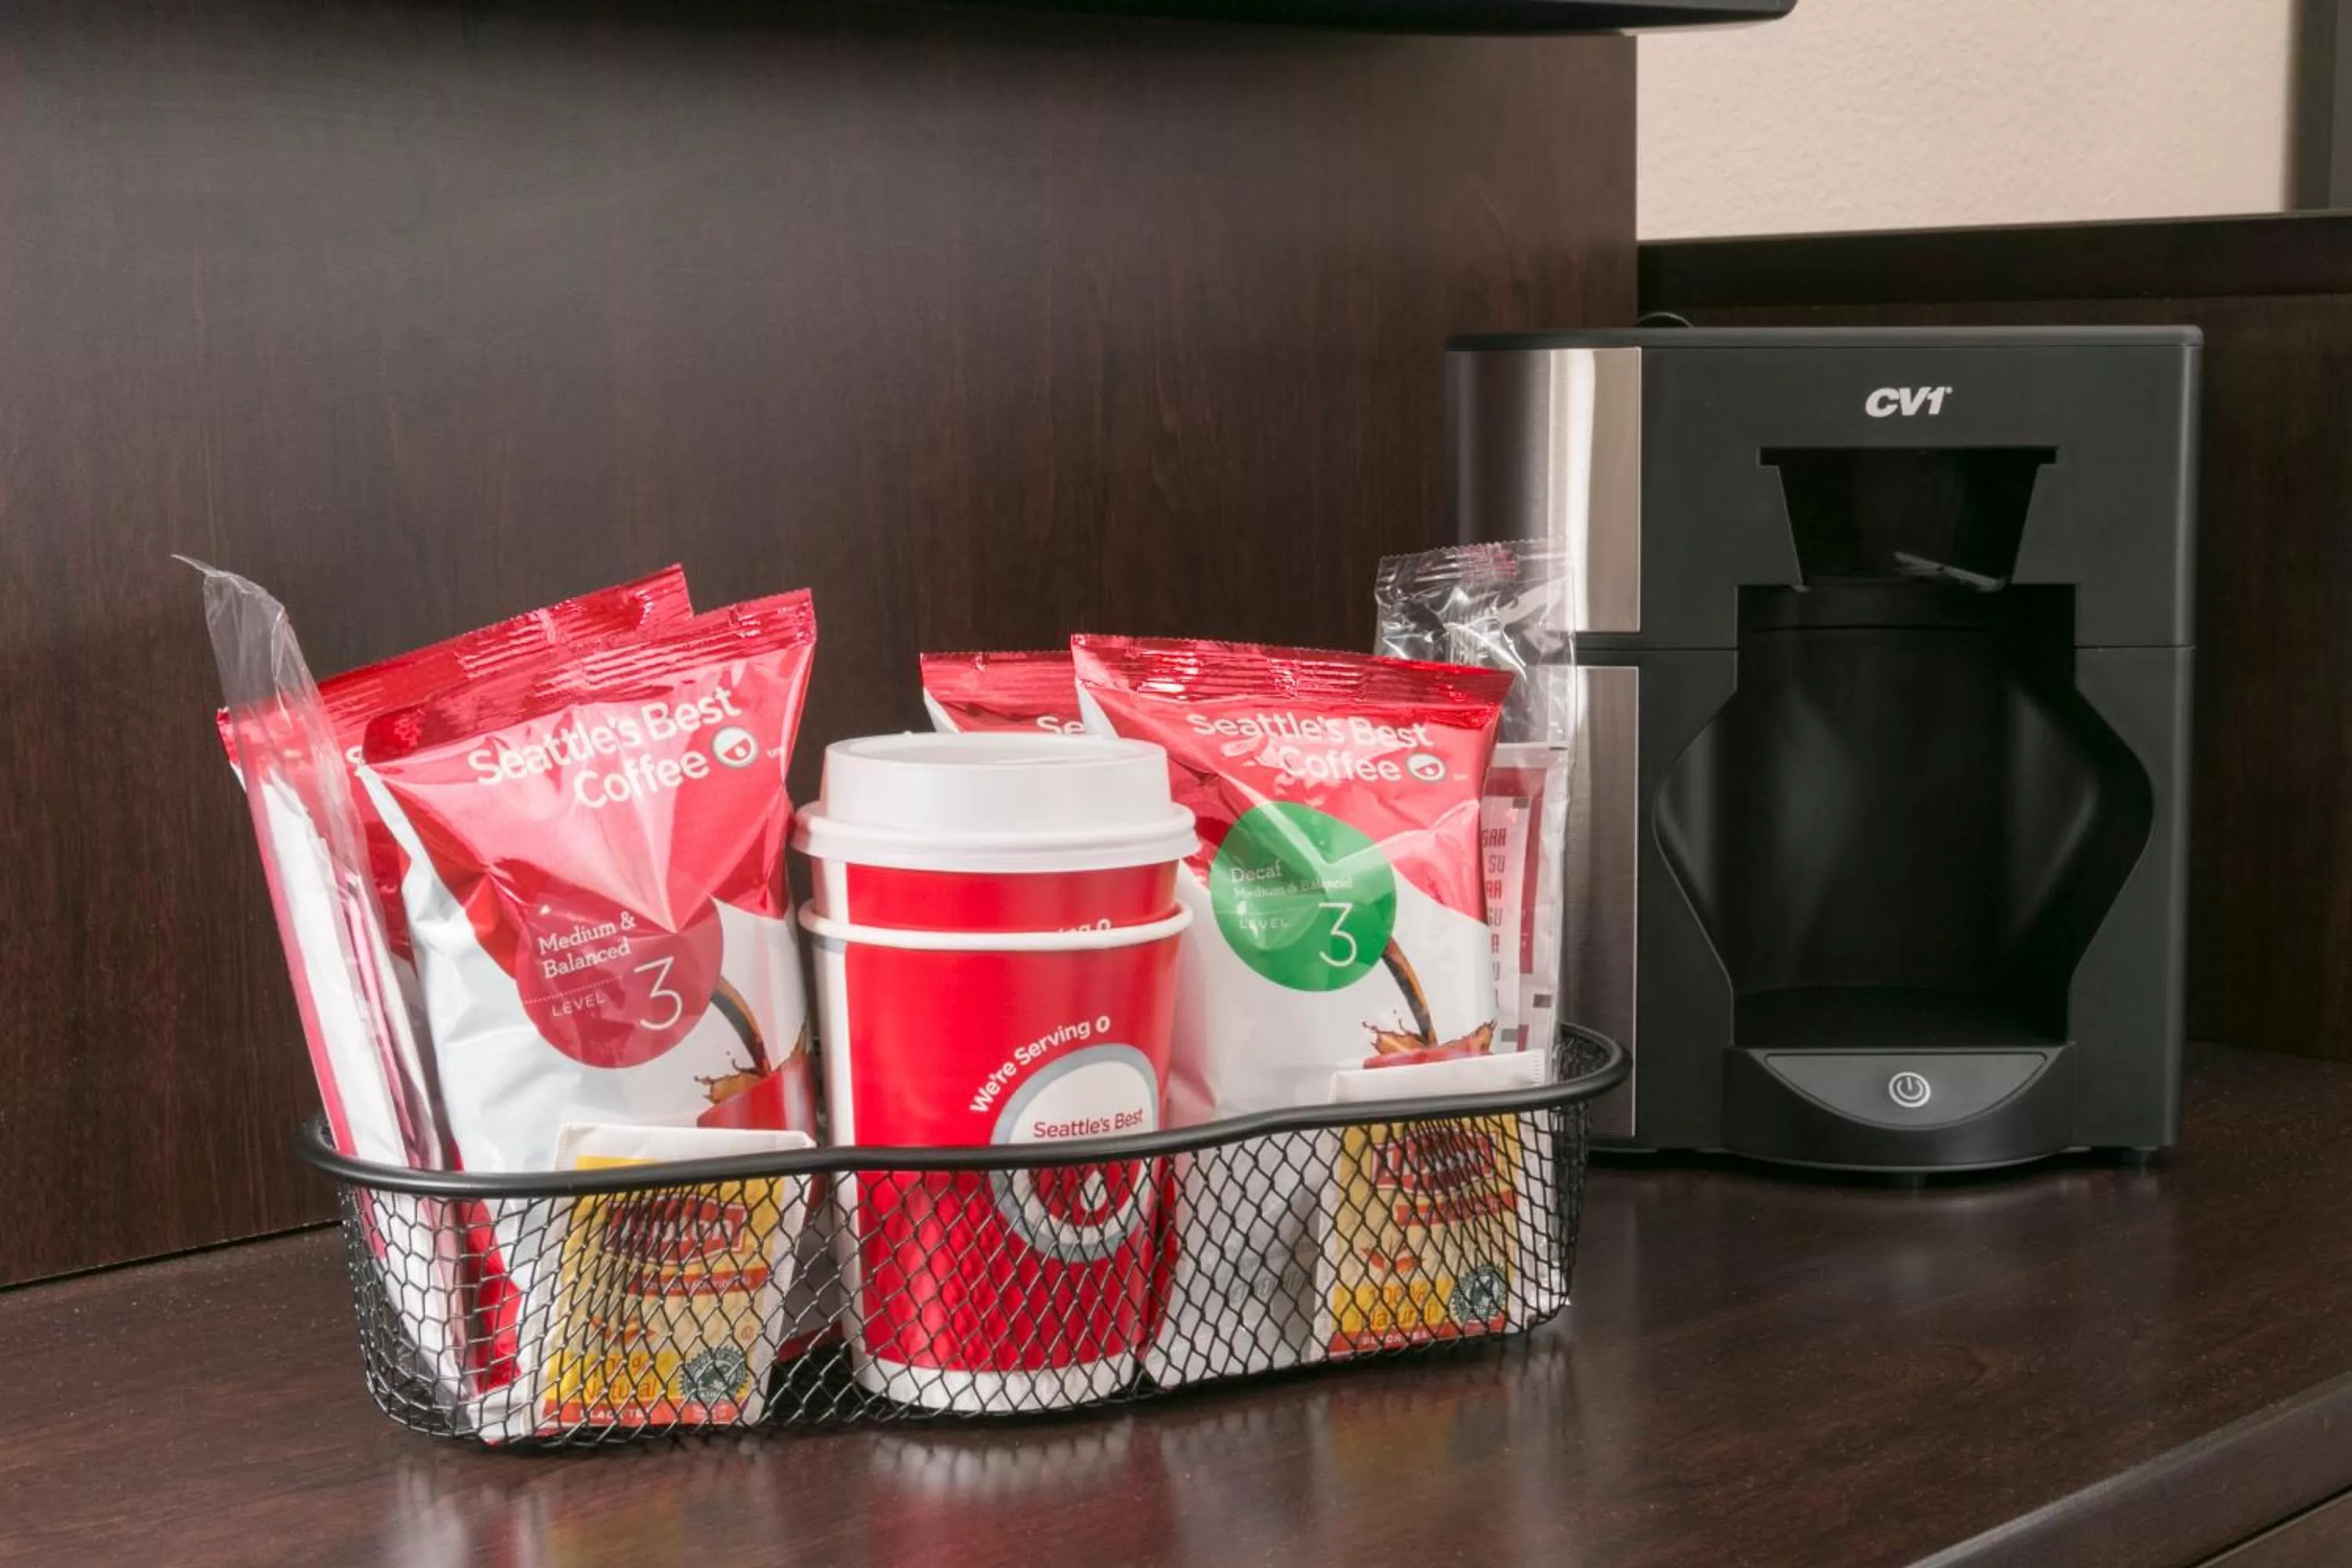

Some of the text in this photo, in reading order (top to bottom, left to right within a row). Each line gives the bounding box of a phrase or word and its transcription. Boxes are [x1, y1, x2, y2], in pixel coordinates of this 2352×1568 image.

[468, 686, 742, 785] Seattle's Best
[1185, 711, 1436, 749] Seattle's Best
[574, 749, 710, 808] Coffee
[1279, 746, 1402, 782] Coffee
[1230, 858, 1283, 882] Decaf
[538, 911, 636, 956] Medium &
[1318, 902, 1357, 967] 3
[542, 937, 631, 979] Balanced
[552, 956, 683, 1030] LEVEL 3
[969, 1061, 1017, 1114] We're
[1014, 1021, 1091, 1066] Serving
[1033, 1107, 1142, 1138] Seattle's Best
